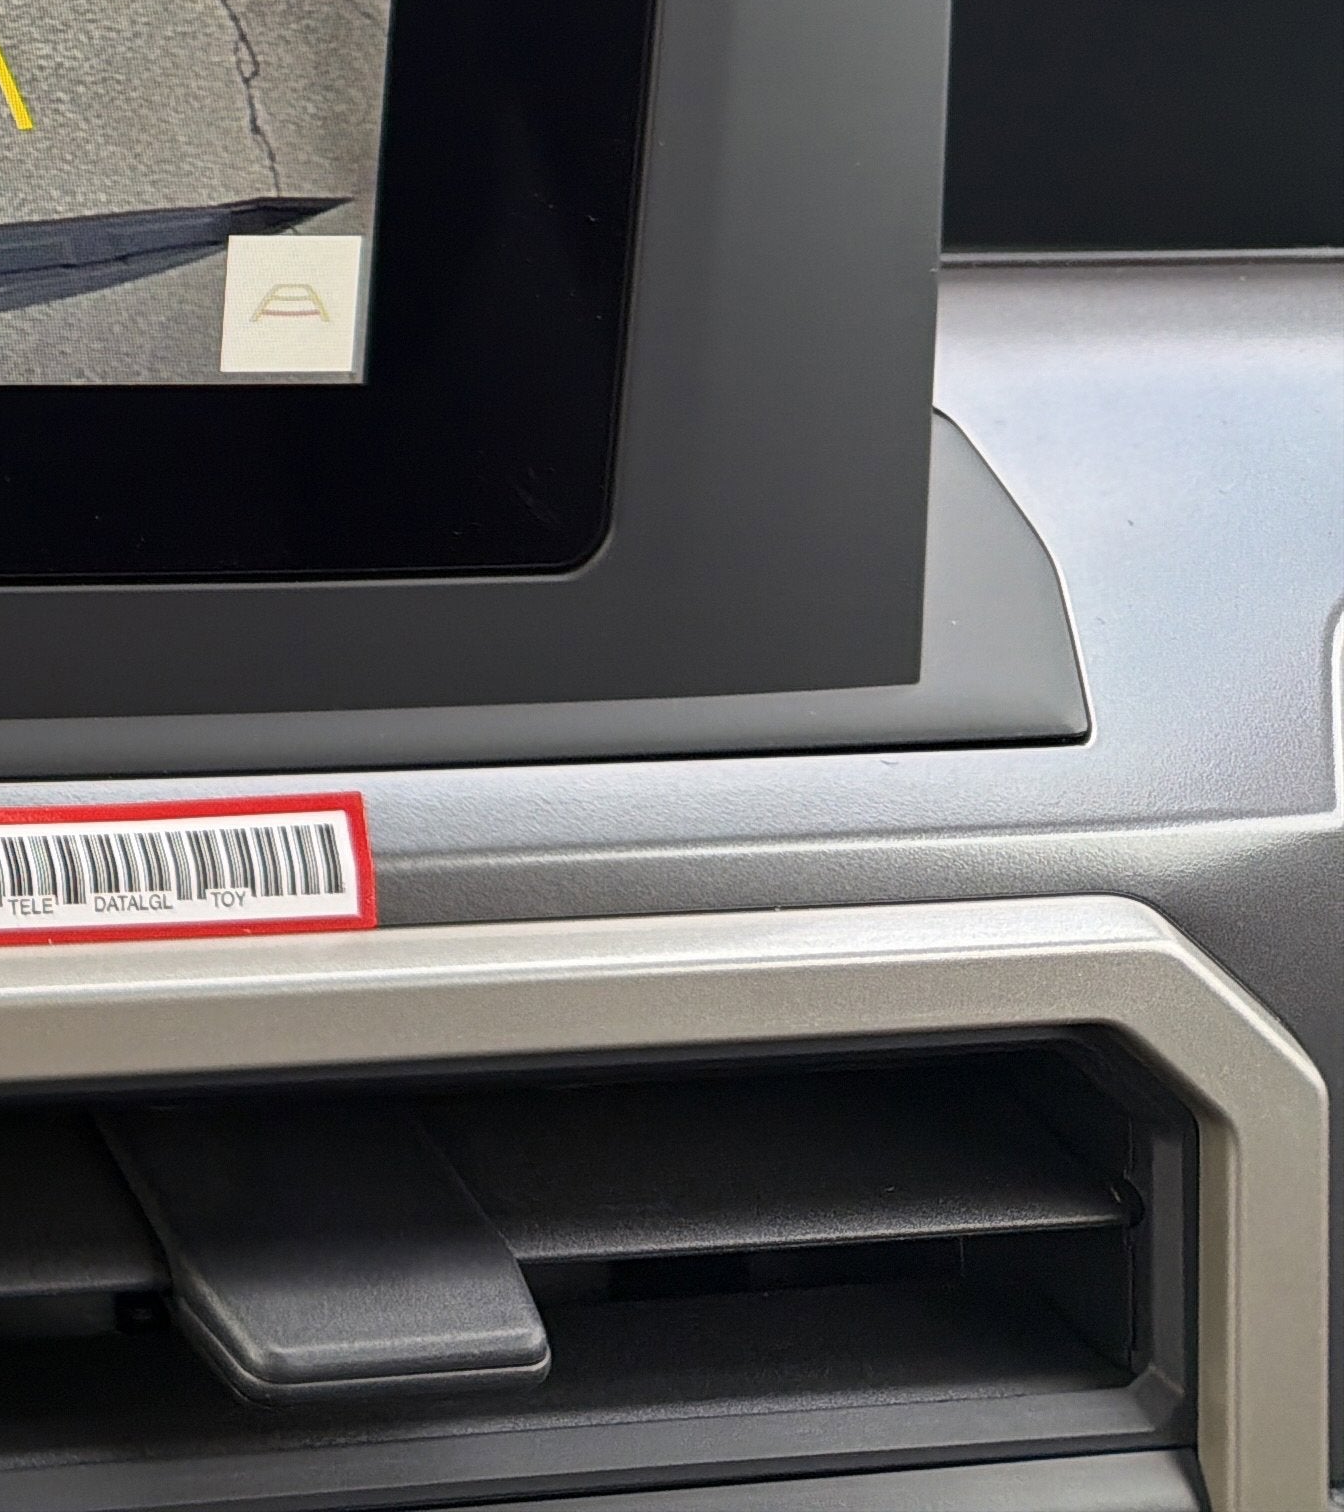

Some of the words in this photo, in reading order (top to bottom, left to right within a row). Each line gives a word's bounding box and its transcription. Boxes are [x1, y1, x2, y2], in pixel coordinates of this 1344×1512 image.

[8, 897, 54, 915] TELE
[94, 893, 173, 913] DATALGL
[211, 890, 247, 908] TOY
